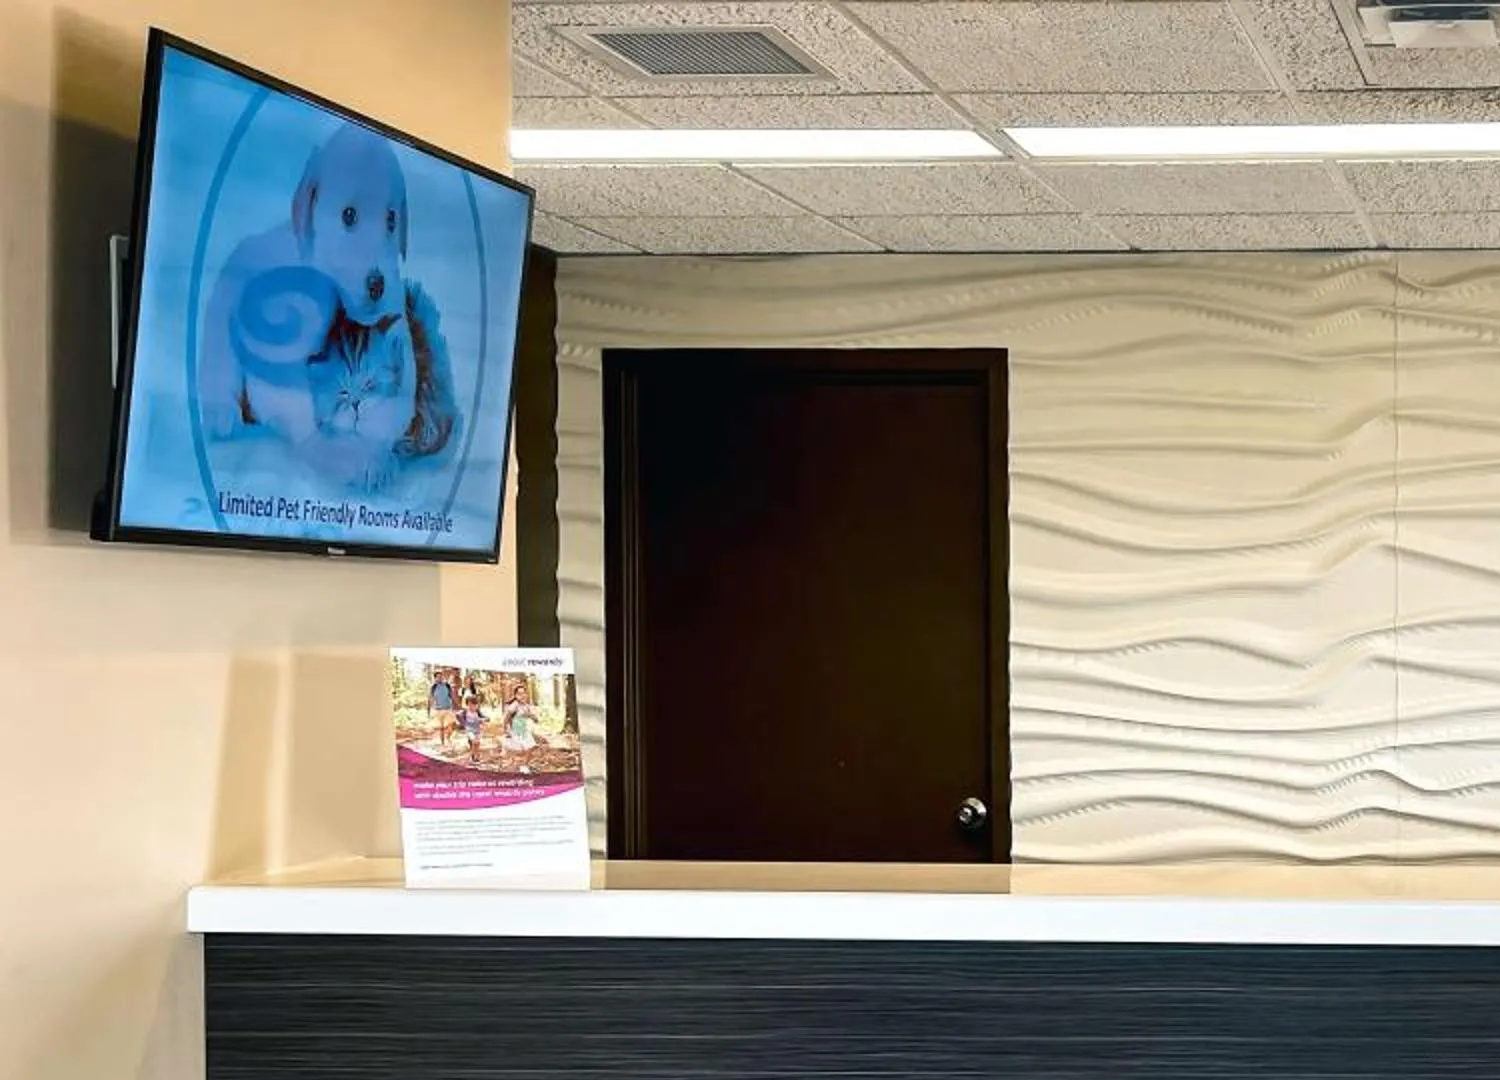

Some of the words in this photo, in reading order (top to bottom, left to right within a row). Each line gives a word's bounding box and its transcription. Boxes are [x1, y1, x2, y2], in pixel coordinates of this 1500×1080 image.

[219, 491, 273, 517] Limited
[277, 497, 300, 520] Pet
[303, 500, 356, 529] Friendly
[359, 505, 399, 528] Rooms
